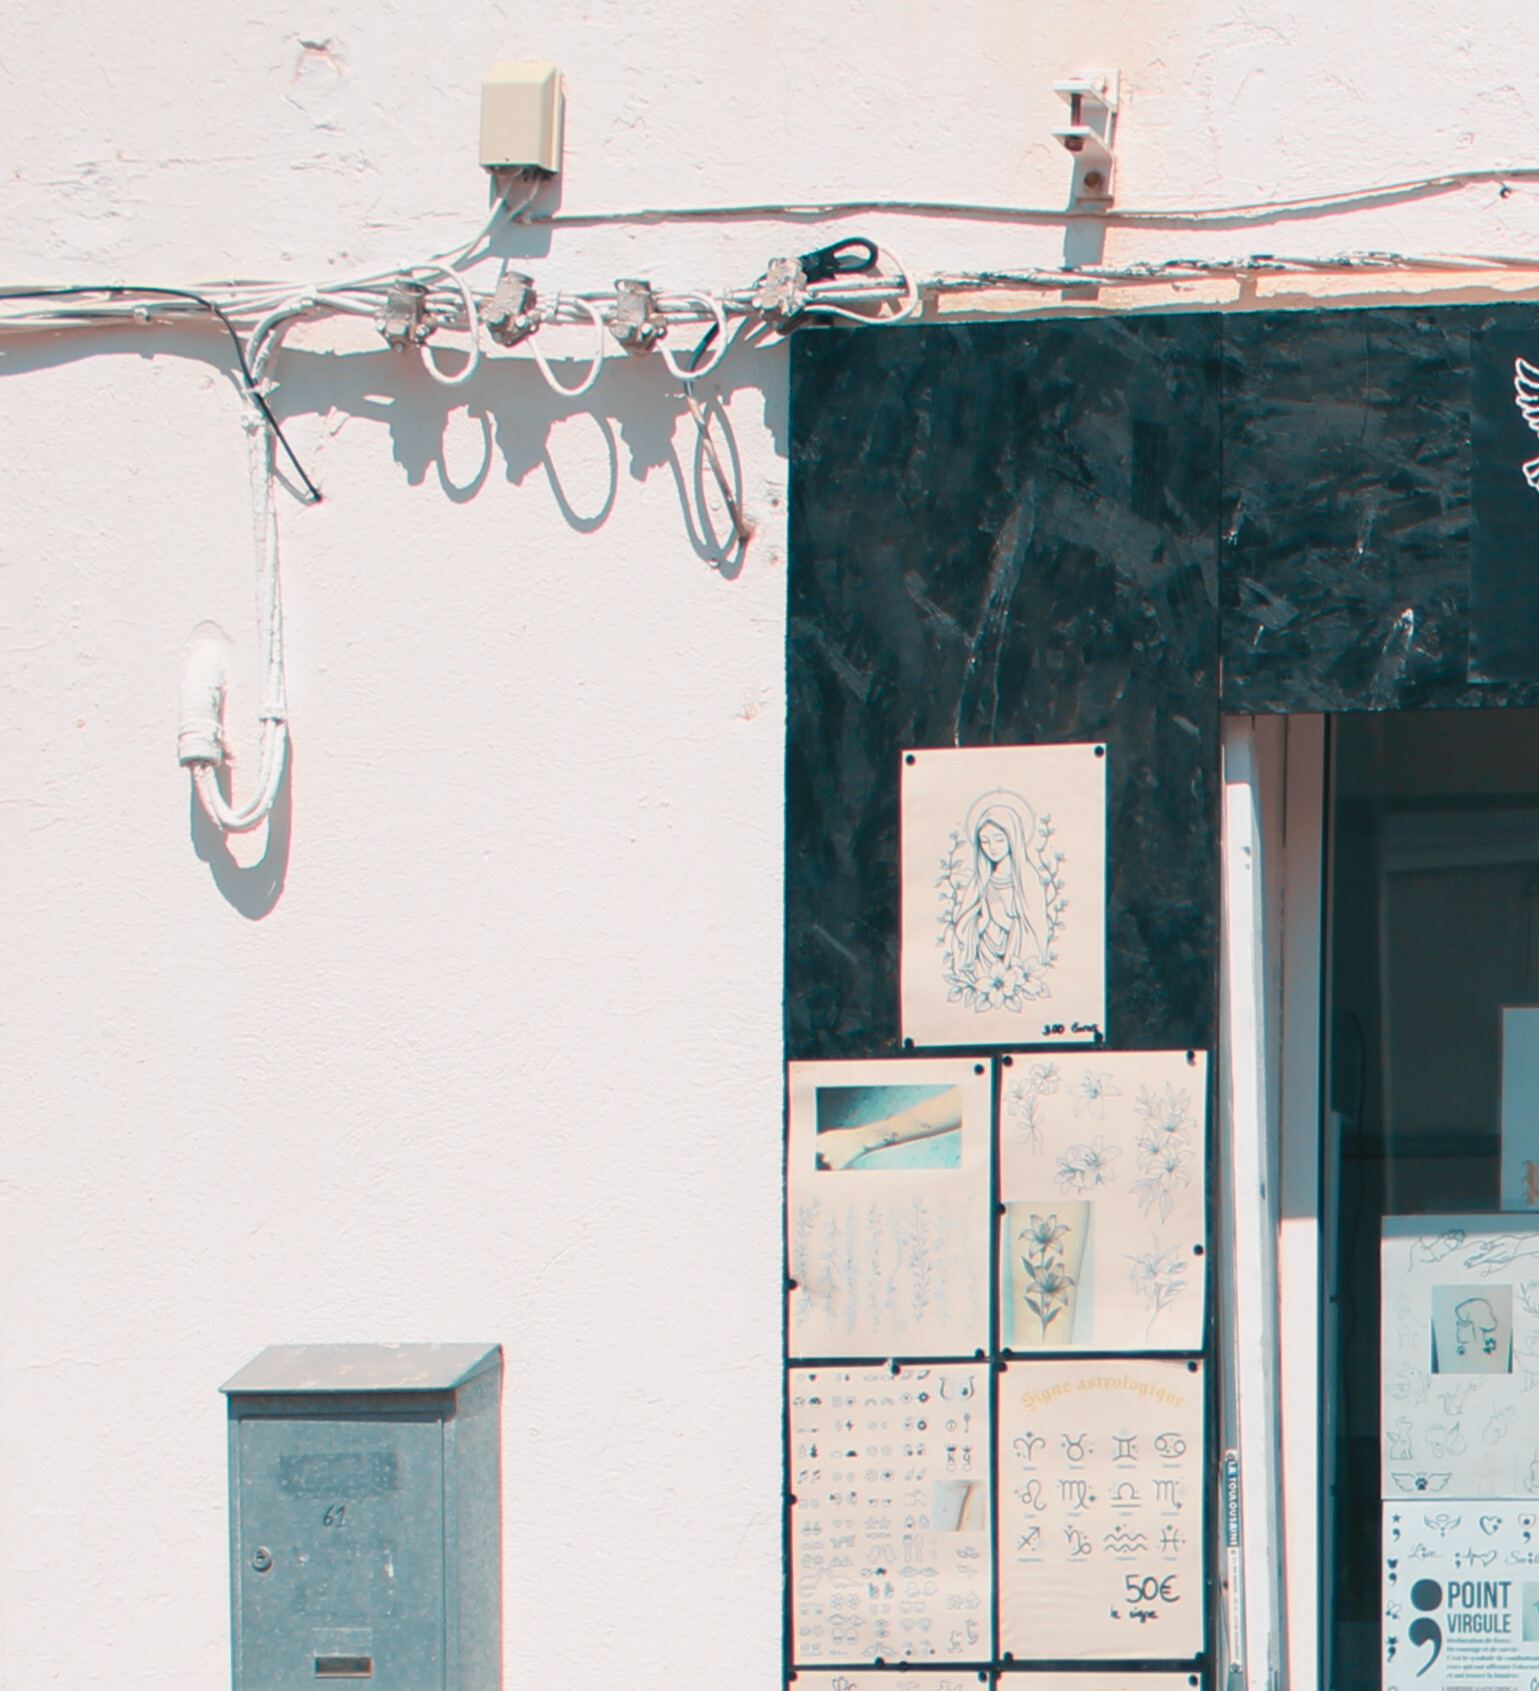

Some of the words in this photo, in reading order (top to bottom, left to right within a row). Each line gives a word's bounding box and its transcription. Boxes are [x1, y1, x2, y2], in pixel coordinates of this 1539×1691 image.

[323, 1506, 347, 1529] 61
[1126, 1575, 1180, 1602] 50€
[1448, 1581, 1512, 1608] POINT
[1447, 1614, 1511, 1633] VIRGULE
